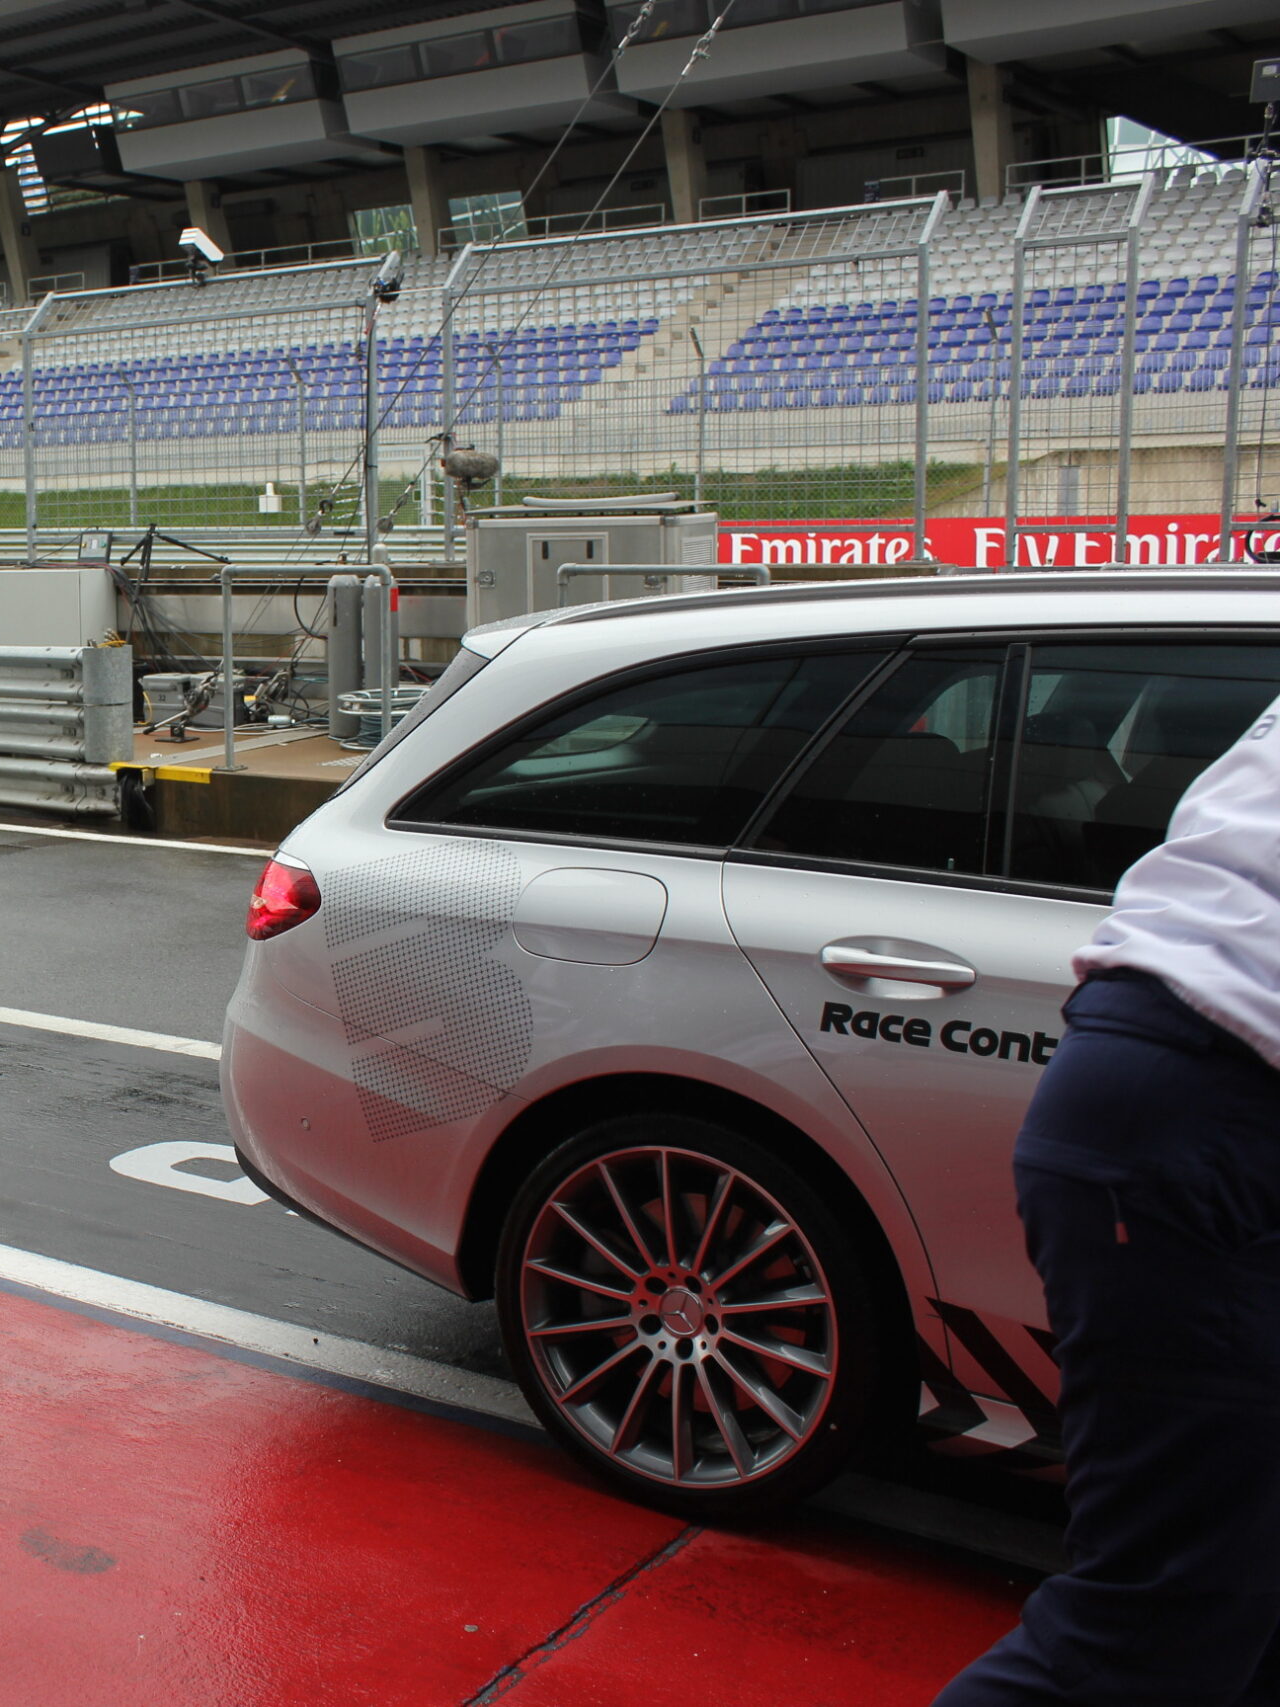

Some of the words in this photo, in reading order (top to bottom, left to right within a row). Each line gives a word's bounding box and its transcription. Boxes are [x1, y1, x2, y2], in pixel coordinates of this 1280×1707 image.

[973, 527, 1060, 567] Fy
[1074, 522, 1280, 565] Emirat
[820, 1001, 932, 1047] Race
[940, 1020, 1059, 1065] Cont
